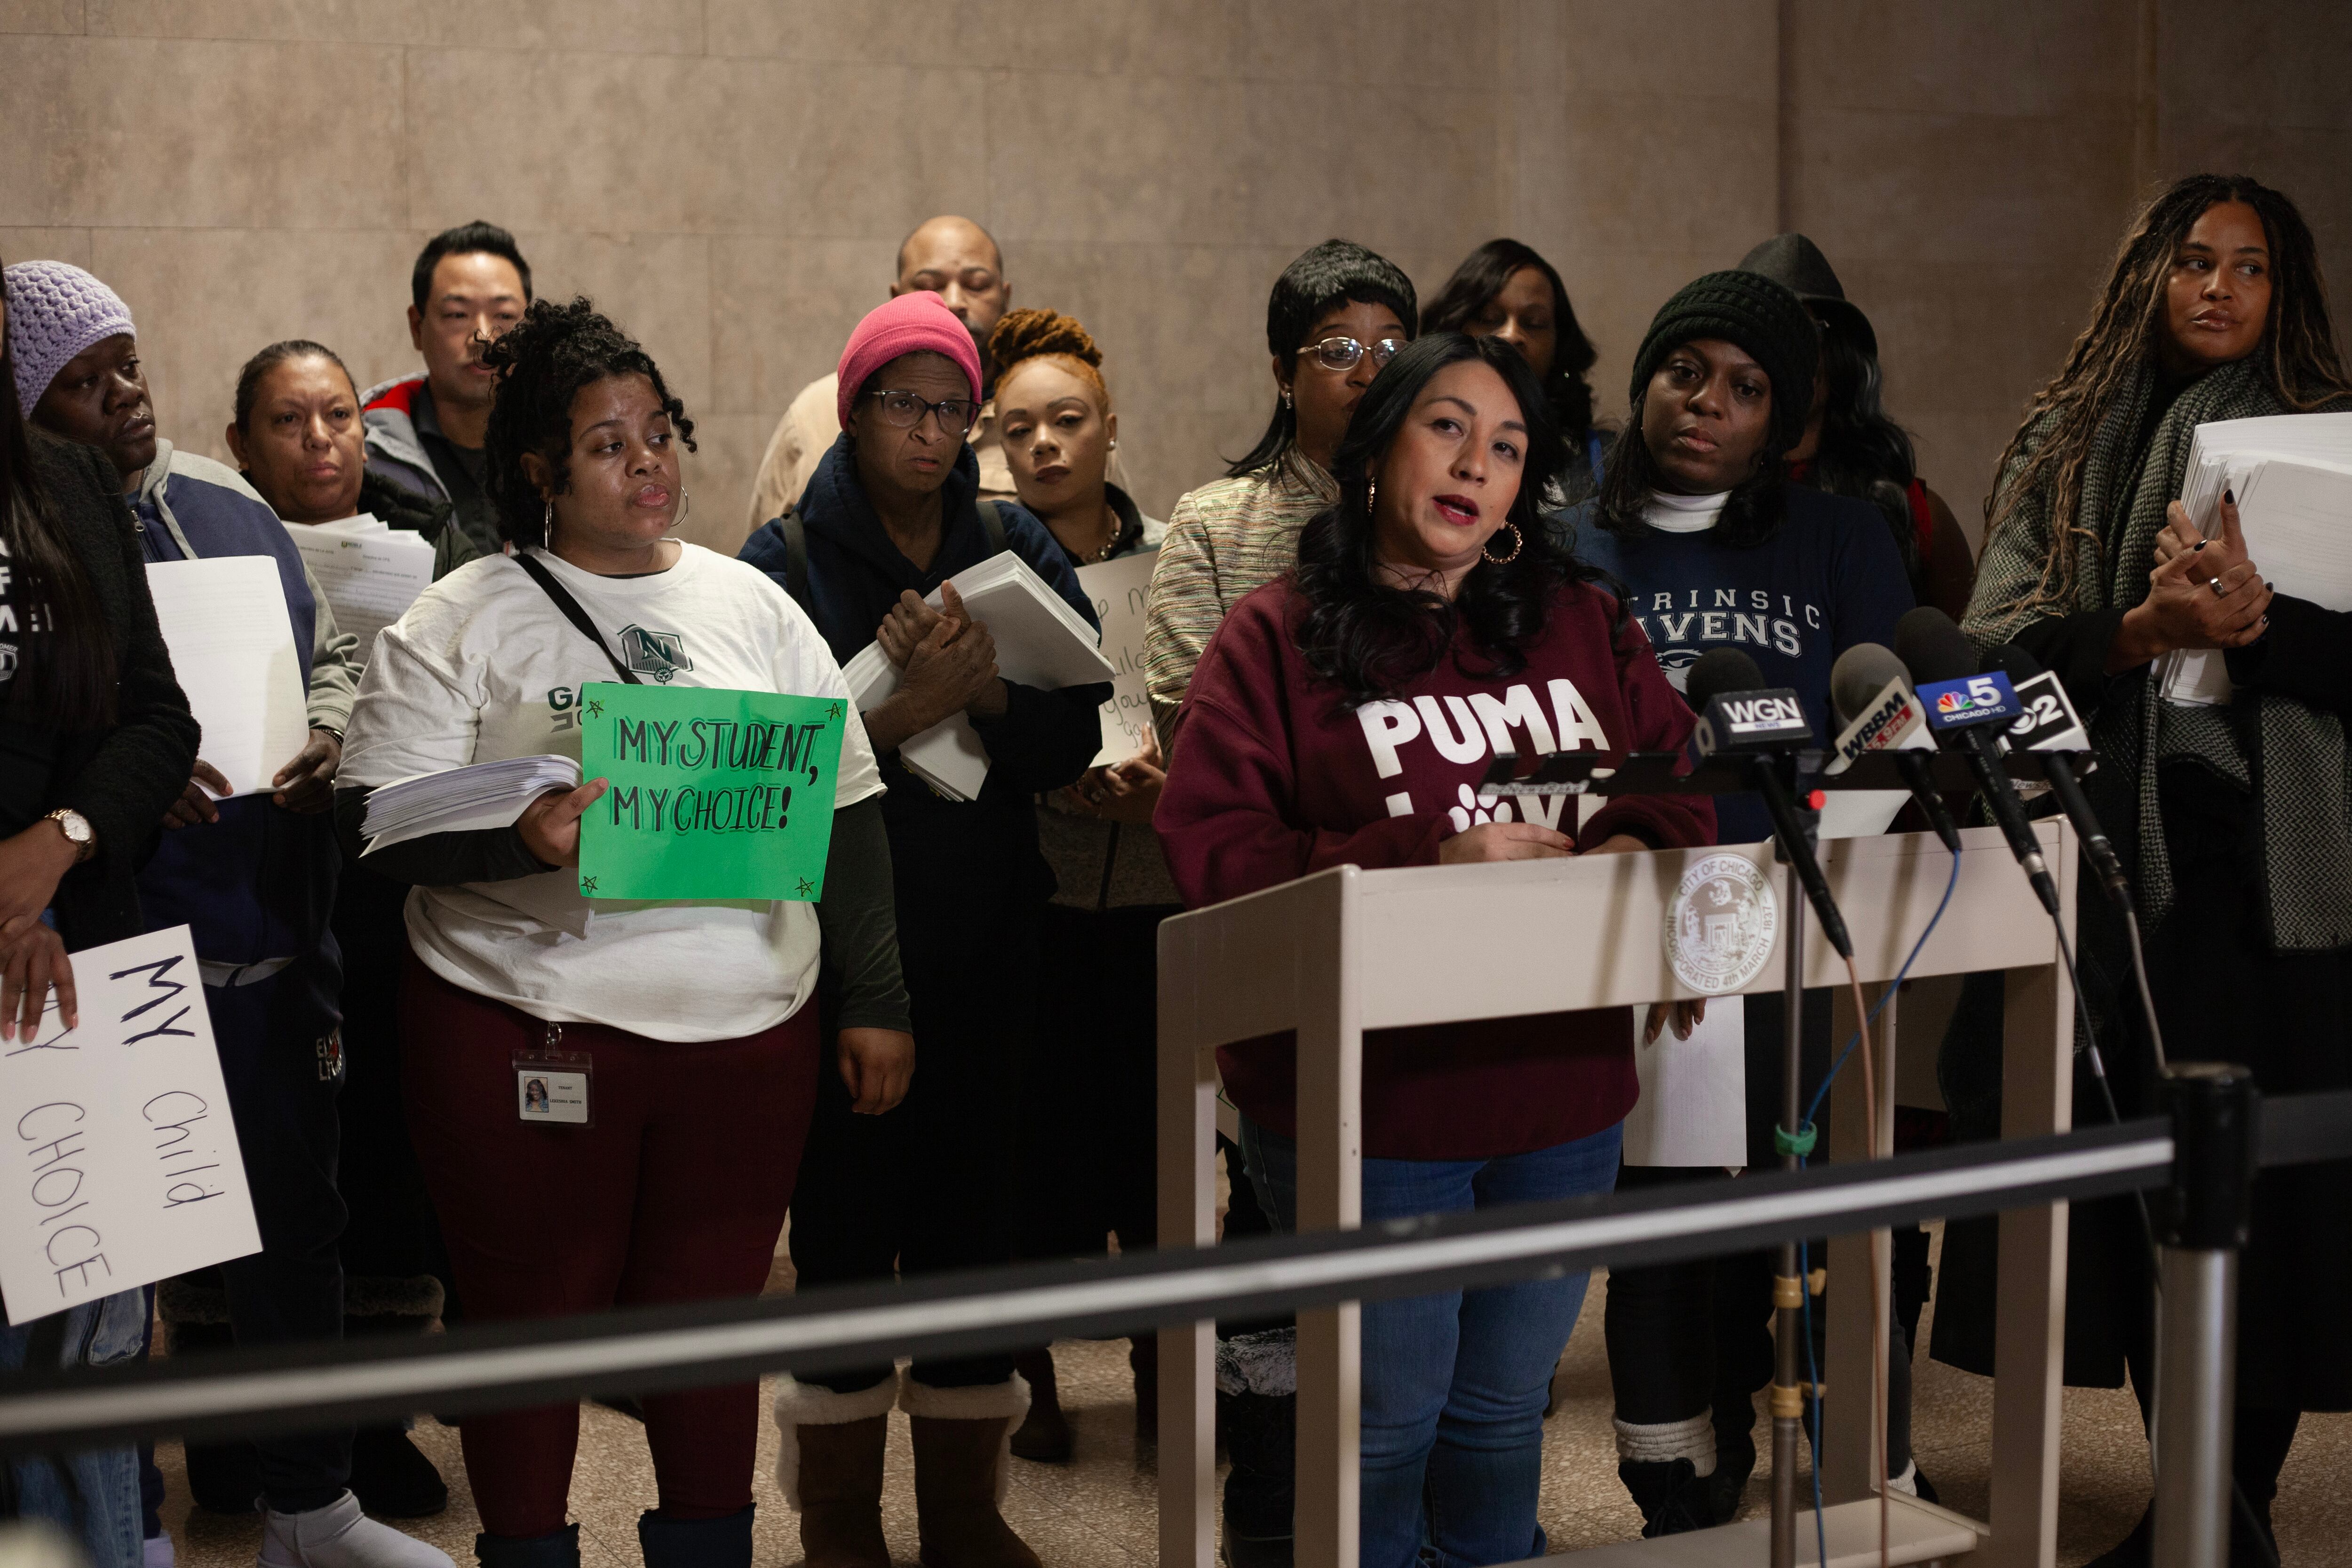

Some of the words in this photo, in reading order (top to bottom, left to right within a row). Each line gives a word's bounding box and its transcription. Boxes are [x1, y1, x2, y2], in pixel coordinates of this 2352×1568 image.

[1721, 697, 1802, 723] WGN
[1943, 708, 1991, 722] CHICAGO
[1991, 705, 2006, 714] HD
[1967, 677, 2002, 706] 5
[620, 718, 678, 766] MY
[680, 720, 825, 787] STUDENT,
[1356, 678, 1610, 779] PUMA
[1843, 692, 1906, 760] WBBM
[614, 786, 668, 832] MY
[674, 786, 792, 832] CHOICE!
[1680, 871, 1700, 895] CITY
[1701, 860, 1716, 876] OF
[1720, 860, 1764, 891] CHICAGO
[1723, 974, 1740, 987] 4th
[1741, 937, 1770, 979] MARCH
[1762, 906, 1773, 931] 1837
[109, 955, 196, 1047] MY
[143, 1091, 225, 1209] Child
[17, 1102, 111, 1298] CHOICE
